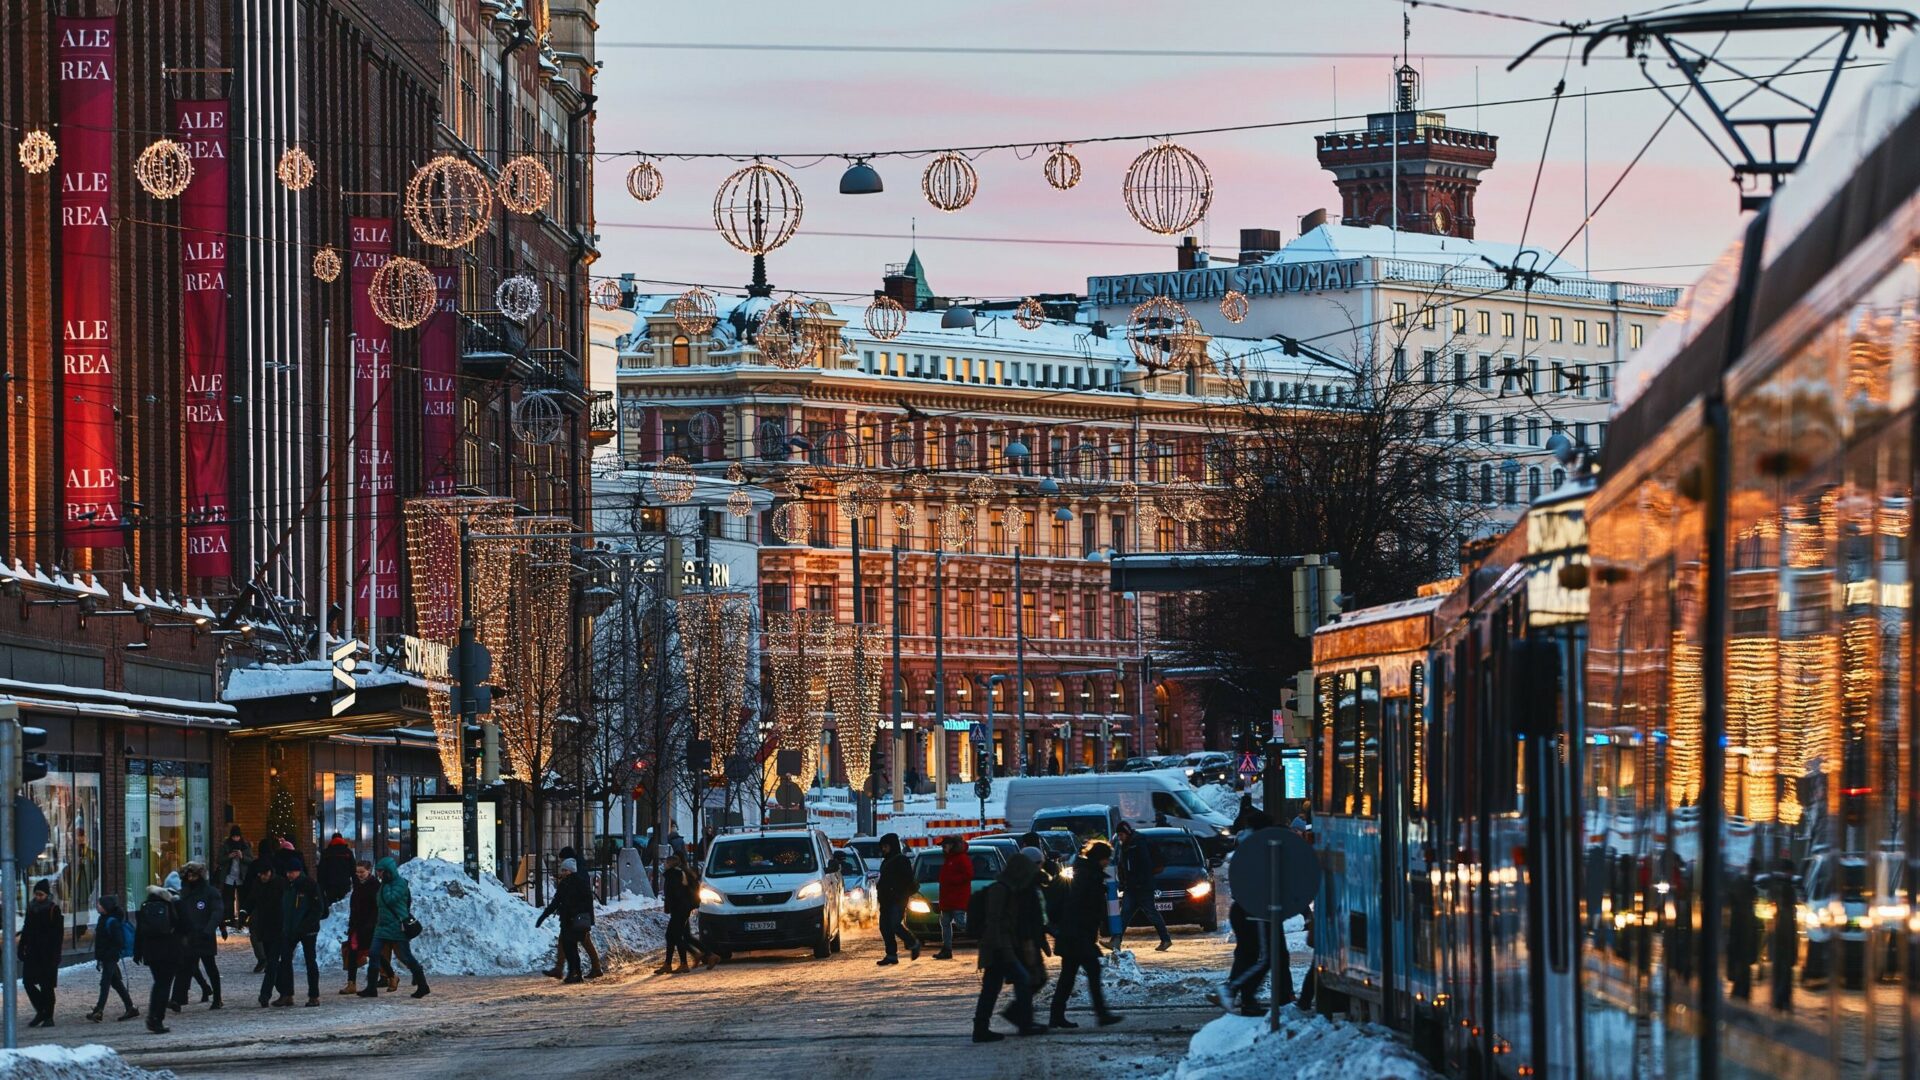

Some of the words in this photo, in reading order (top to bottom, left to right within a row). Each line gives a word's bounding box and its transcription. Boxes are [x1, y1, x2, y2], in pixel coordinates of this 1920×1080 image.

[60, 29, 110, 48] ALE
[60, 61, 110, 81] REA
[179, 111, 223, 129] ALE
[180, 141, 225, 159] REA
[62, 172, 108, 193] ALE
[62, 206, 109, 226] REA
[185, 242, 225, 261] ALE
[186, 272, 225, 291] REA
[1095, 270, 1227, 304] HELSINGIN
[1234, 260, 1358, 295] SANOMAT
[63, 320, 108, 340] ALE
[63, 354, 111, 375] REA
[187, 374, 222, 393] ALE
[187, 404, 224, 423] REA
[66, 468, 115, 488] ALE
[189, 536, 228, 554] REA
